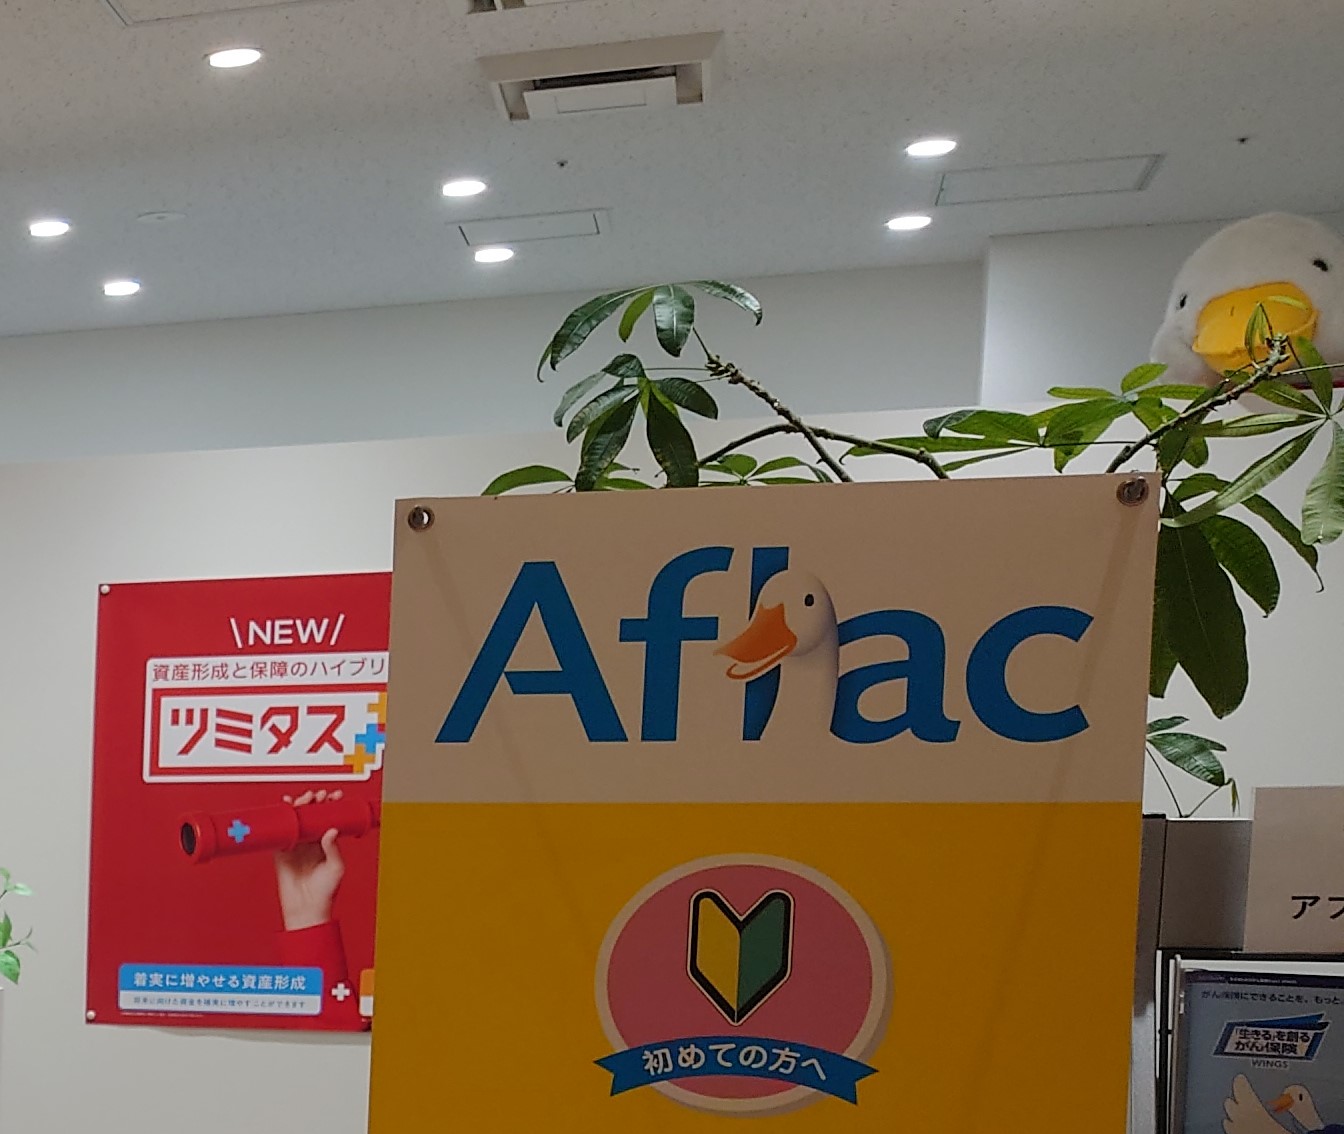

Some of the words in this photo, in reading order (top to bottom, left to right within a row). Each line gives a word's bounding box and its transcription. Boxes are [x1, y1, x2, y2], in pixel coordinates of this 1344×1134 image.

[248, 619, 329, 645] NEW
[434, 545, 1095, 744] Aflac
[170, 704, 346, 756] ツミタス
[133, 971, 306, 992] 着実に増やせる資産形成
[643, 1042, 828, 1082] 初めての方へ
[1251, 1059, 1288, 1069] WINGS
